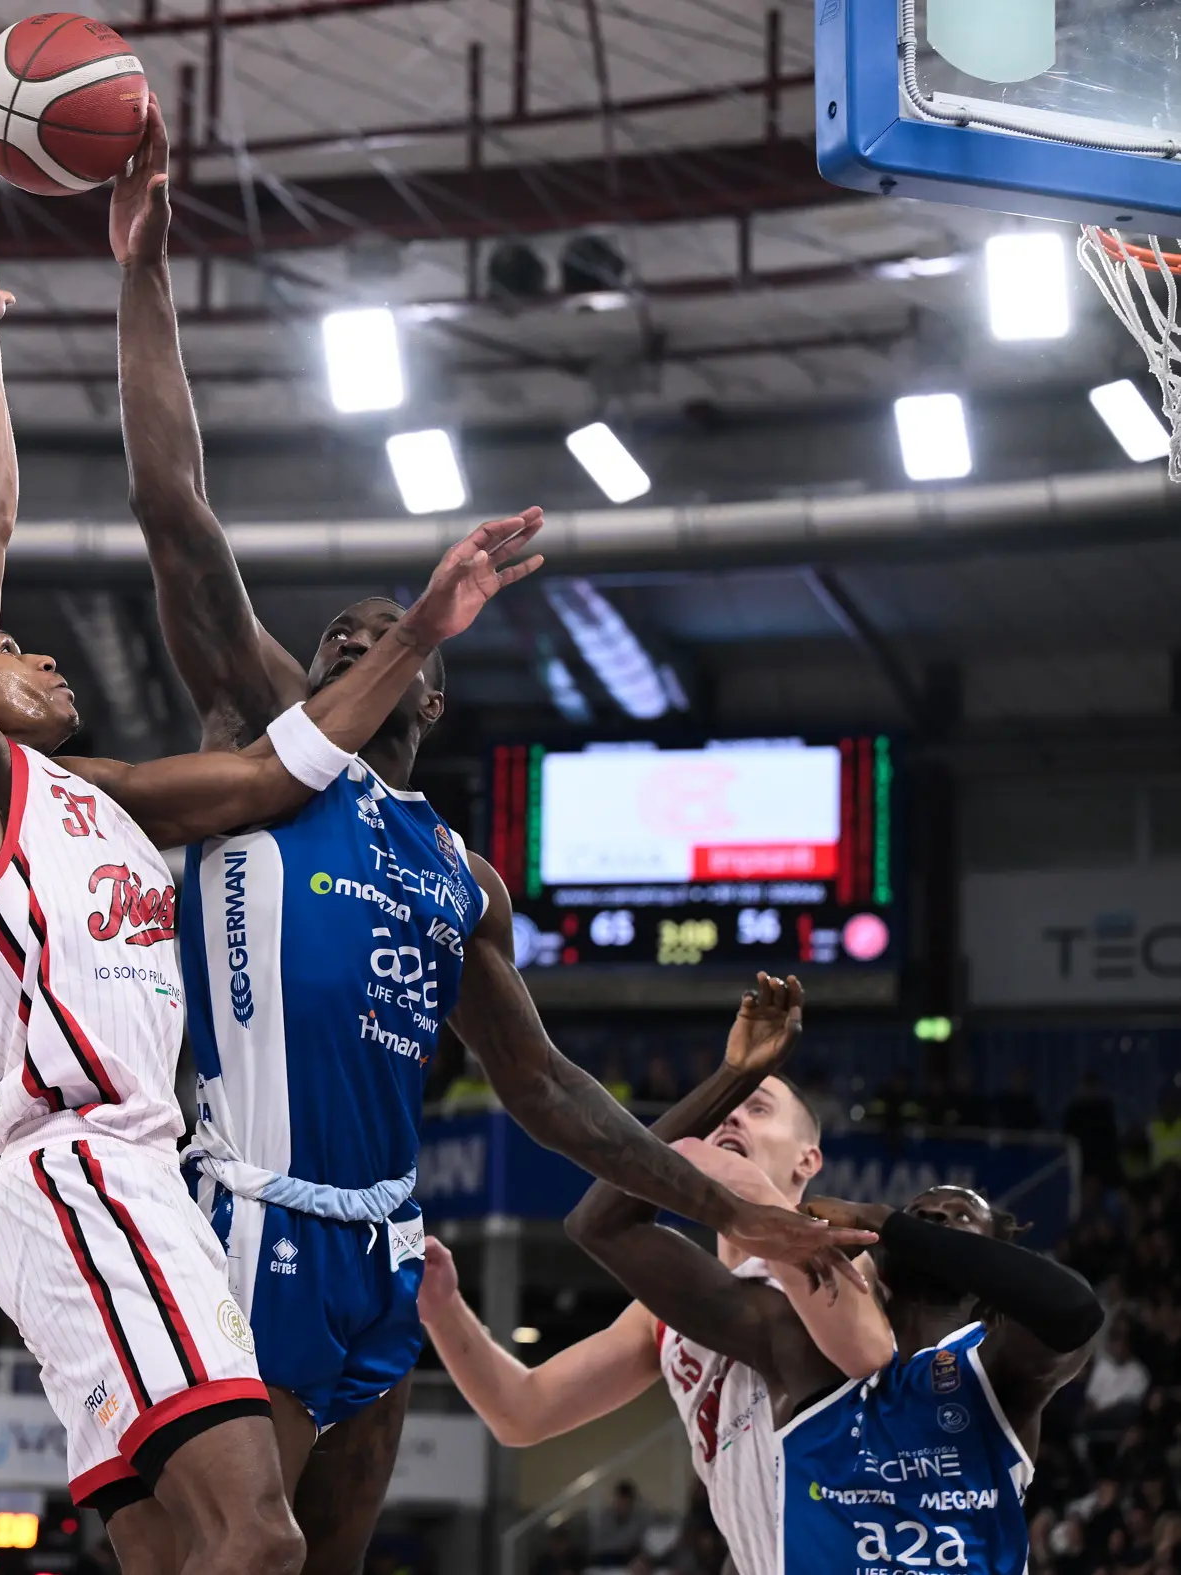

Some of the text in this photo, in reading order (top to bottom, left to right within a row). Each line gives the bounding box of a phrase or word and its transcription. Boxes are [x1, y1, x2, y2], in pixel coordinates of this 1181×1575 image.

[50, 784, 108, 841] 37
[358, 809, 385, 830] errea
[223, 850, 249, 974] GERMANI
[94, 966, 111, 980] IO
[366, 981, 394, 1004] LIFE
[270, 1260, 297, 1275] errea
[853, 1520, 969, 1568] a2a
